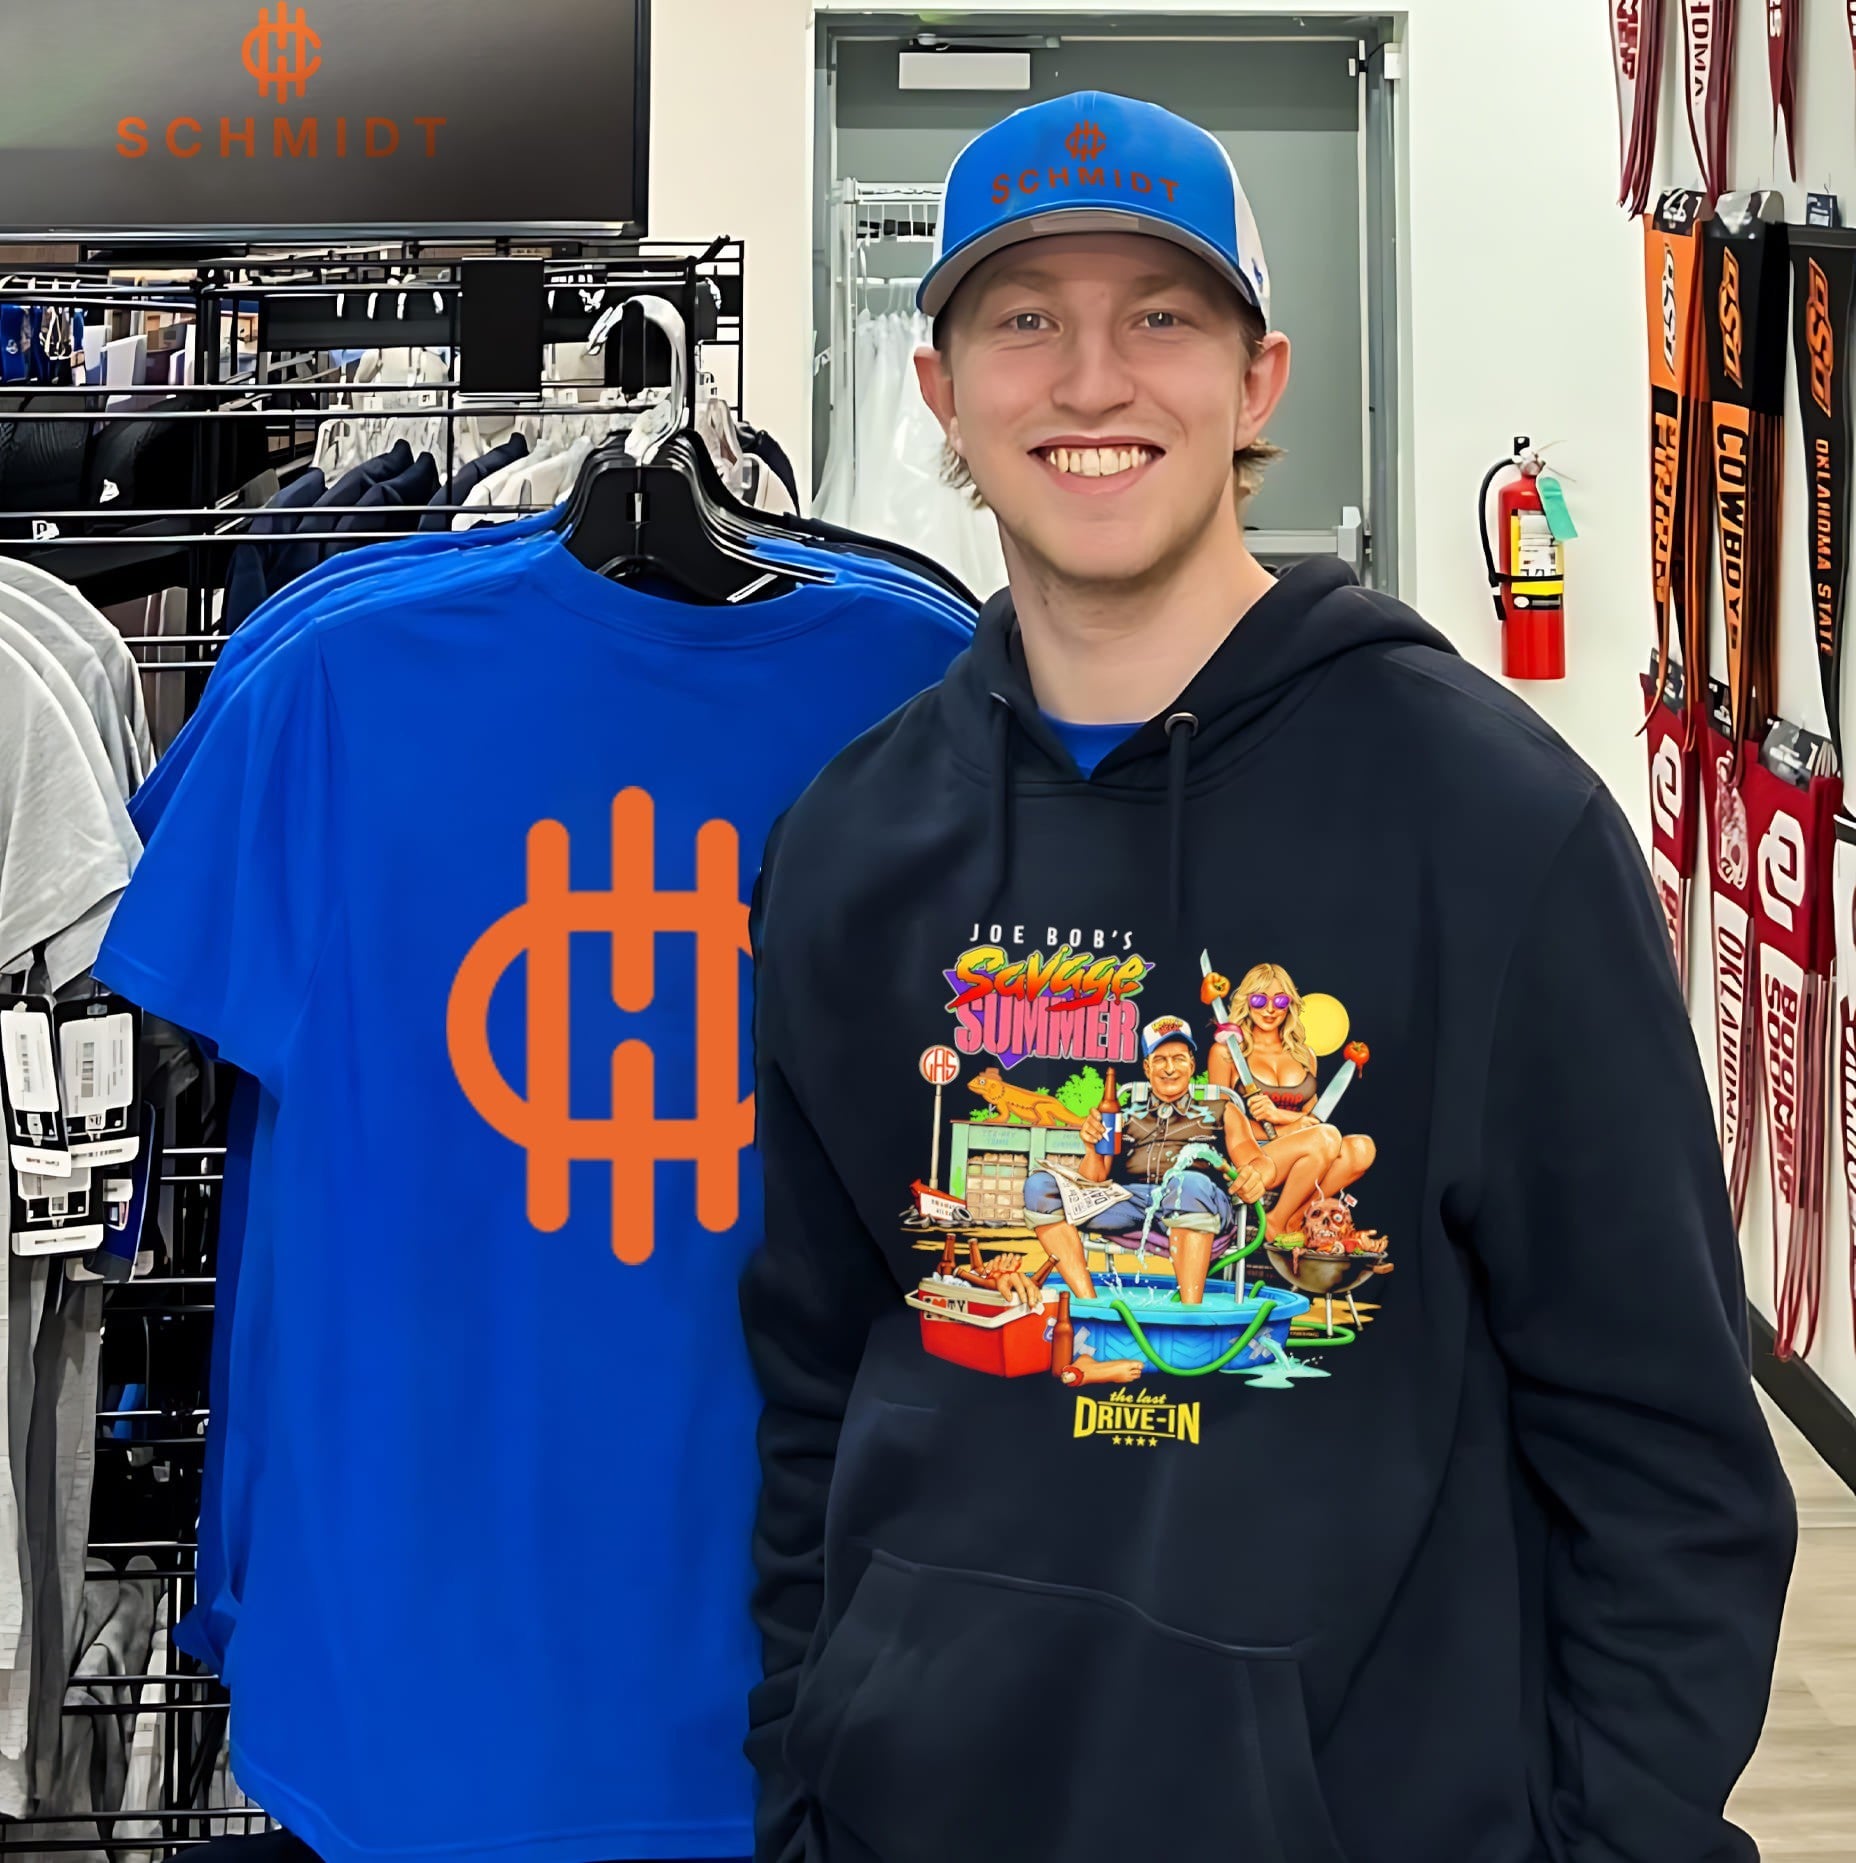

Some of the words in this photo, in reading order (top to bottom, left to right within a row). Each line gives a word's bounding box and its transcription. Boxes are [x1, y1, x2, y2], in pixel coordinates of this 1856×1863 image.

[115, 116, 448, 159] SCHMIDT
[991, 167, 1180, 205] SCHMIDT
[1815, 438, 1832, 571] OKLAHOMA
[970, 923, 1025, 944] JOE
[1046, 926, 1134, 950] BOB'S
[946, 945, 1147, 1012] Savage
[954, 994, 1140, 1062] SUMMER
[1718, 925, 1746, 1145] OKLAHOMA
[922, 1047, 957, 1083] GAS
[1109, 1386, 1134, 1403] the
[1136, 1387, 1167, 1404] last
[1073, 1395, 1200, 1445] DRIVE-IN
